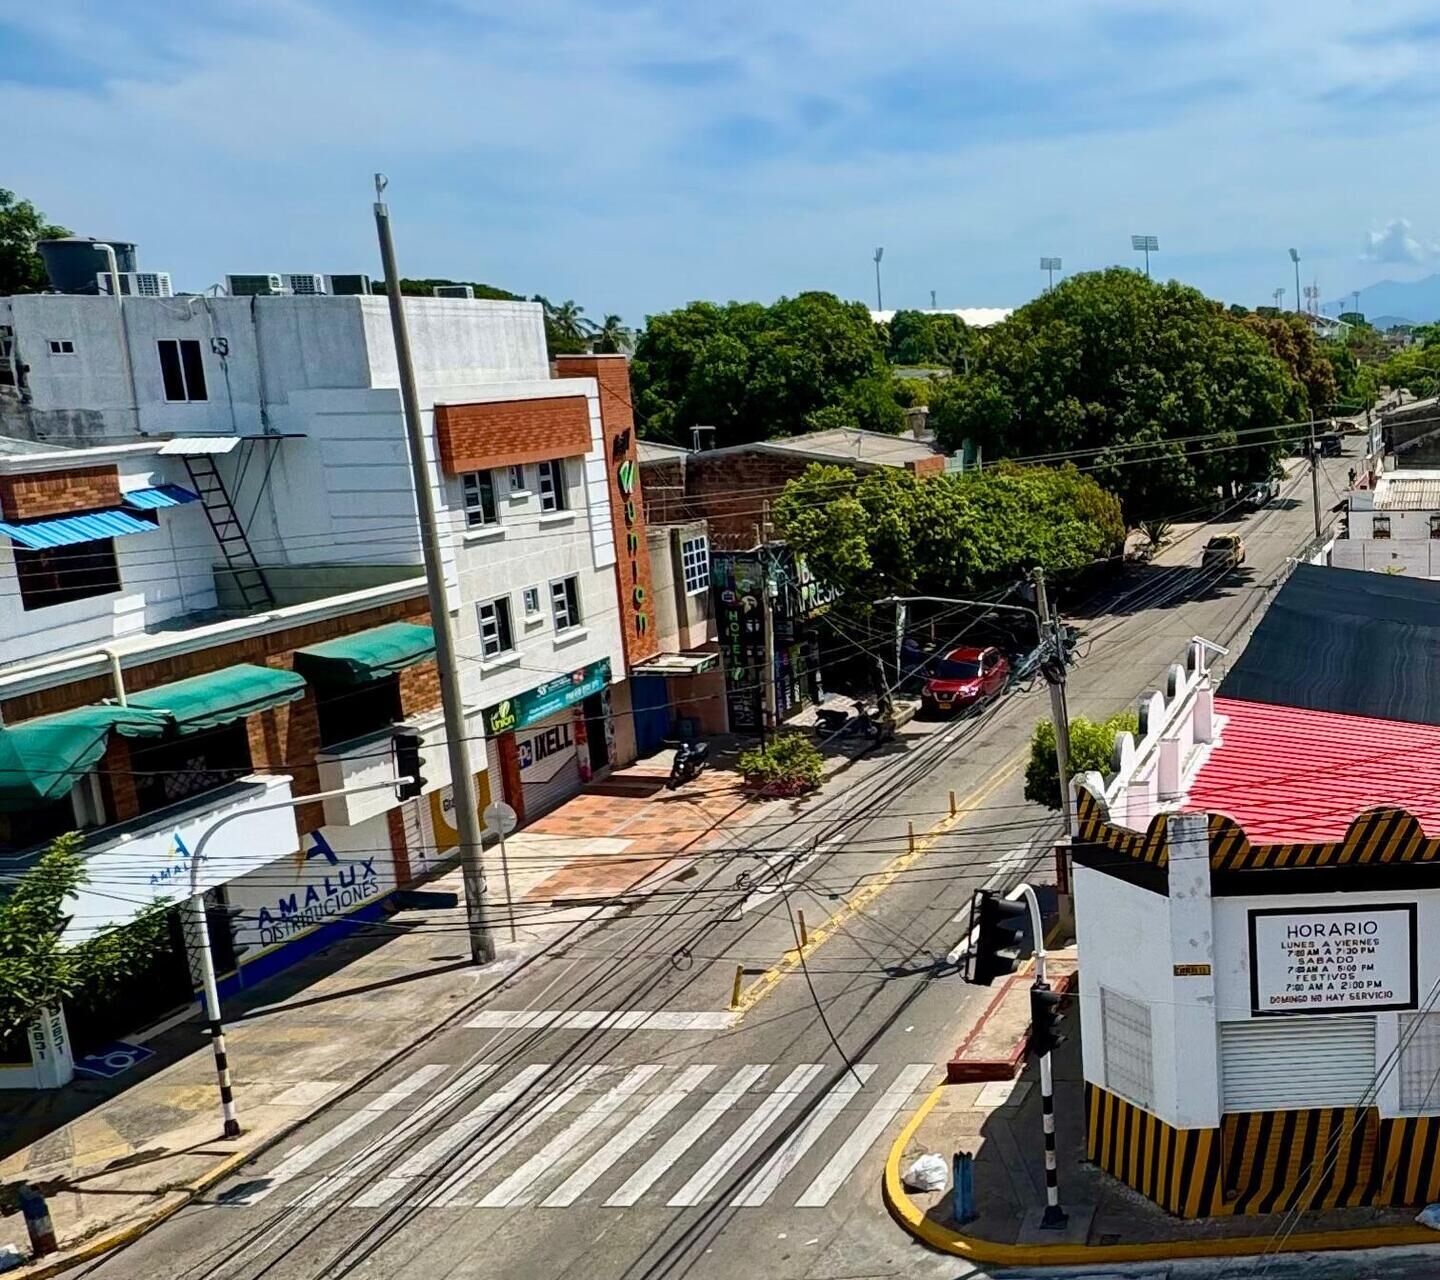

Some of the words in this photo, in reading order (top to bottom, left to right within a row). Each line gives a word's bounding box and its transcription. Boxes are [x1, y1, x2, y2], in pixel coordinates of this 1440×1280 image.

[534, 723, 573, 761] IXELL
[258, 856, 378, 930] AMALUX
[260, 877, 380, 948] DISTRIBUCIONES
[1287, 921, 1378, 939] HORARIO
[1281, 941, 1315, 949] LUNES
[1335, 938, 1380, 947] VIERNES
[1307, 948, 1319, 956] AM
[1361, 946, 1375, 954] PM
[1298, 956, 1354, 965] SABADO
[1296, 973, 1355, 982] FESTIVOS
[1327, 982, 1334, 990] A
[1341, 981, 1364, 990] 2:00
[1367, 980, 1382, 989] PM
[1269, 995, 1308, 1004] DOMINGO
[1311, 994, 1322, 1002] NO
[1326, 993, 1345, 1002] HAY
[1349, 990, 1393, 1000] SERVICIO
